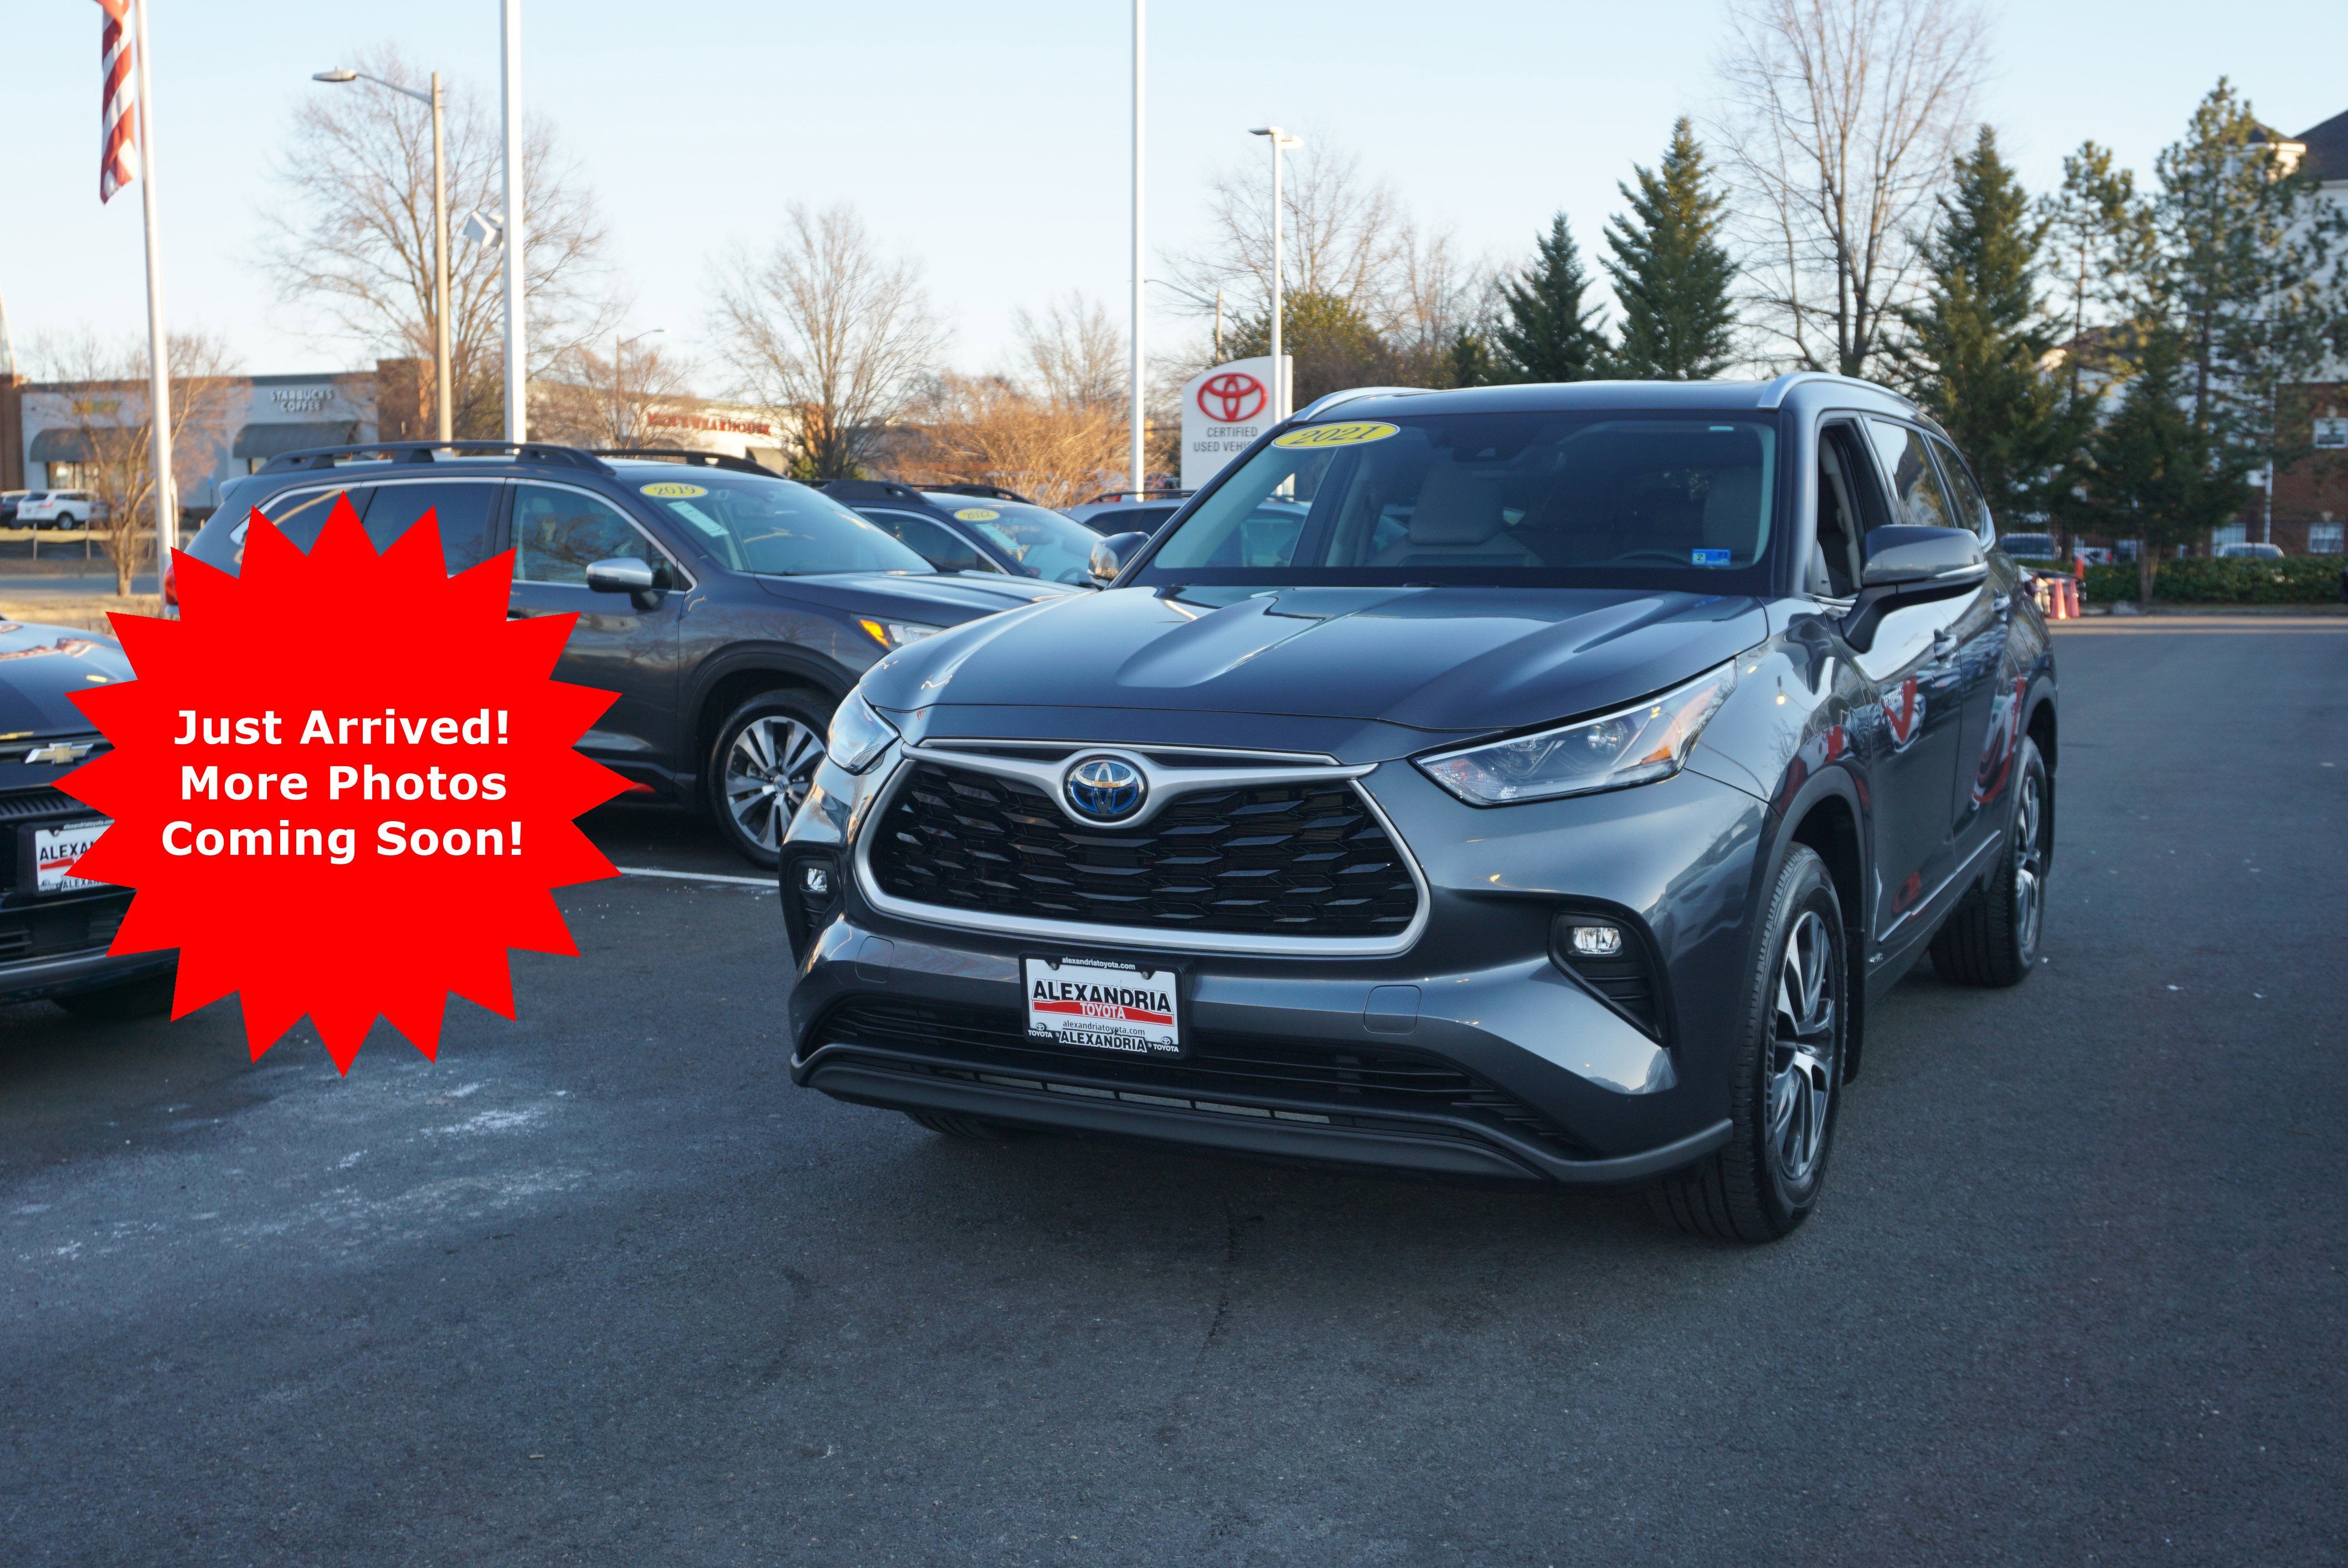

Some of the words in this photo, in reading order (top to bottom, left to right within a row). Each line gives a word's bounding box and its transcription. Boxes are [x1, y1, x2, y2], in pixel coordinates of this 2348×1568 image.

[269, 389, 334, 401] STARBUCKS
[281, 400, 322, 411] COFFEE
[1207, 426, 1258, 437] CERTIFIED
[1288, 425, 1382, 445] 2021
[1193, 441, 1220, 452] USED
[654, 486, 696, 495] 2019
[1062, 957, 1135, 970] alexandriatoyota.com
[1033, 980, 1172, 1013] ALEXANDRIA
[1080, 1003, 1126, 1019] TOYOTA
[1028, 1029, 1053, 1038] TOYOTA
[1063, 1020, 1145, 1036] alexandriatoyota.com
[1059, 1029, 1147, 1053] ALEXANDRIA
[1153, 1044, 1179, 1053] TOYOTA
